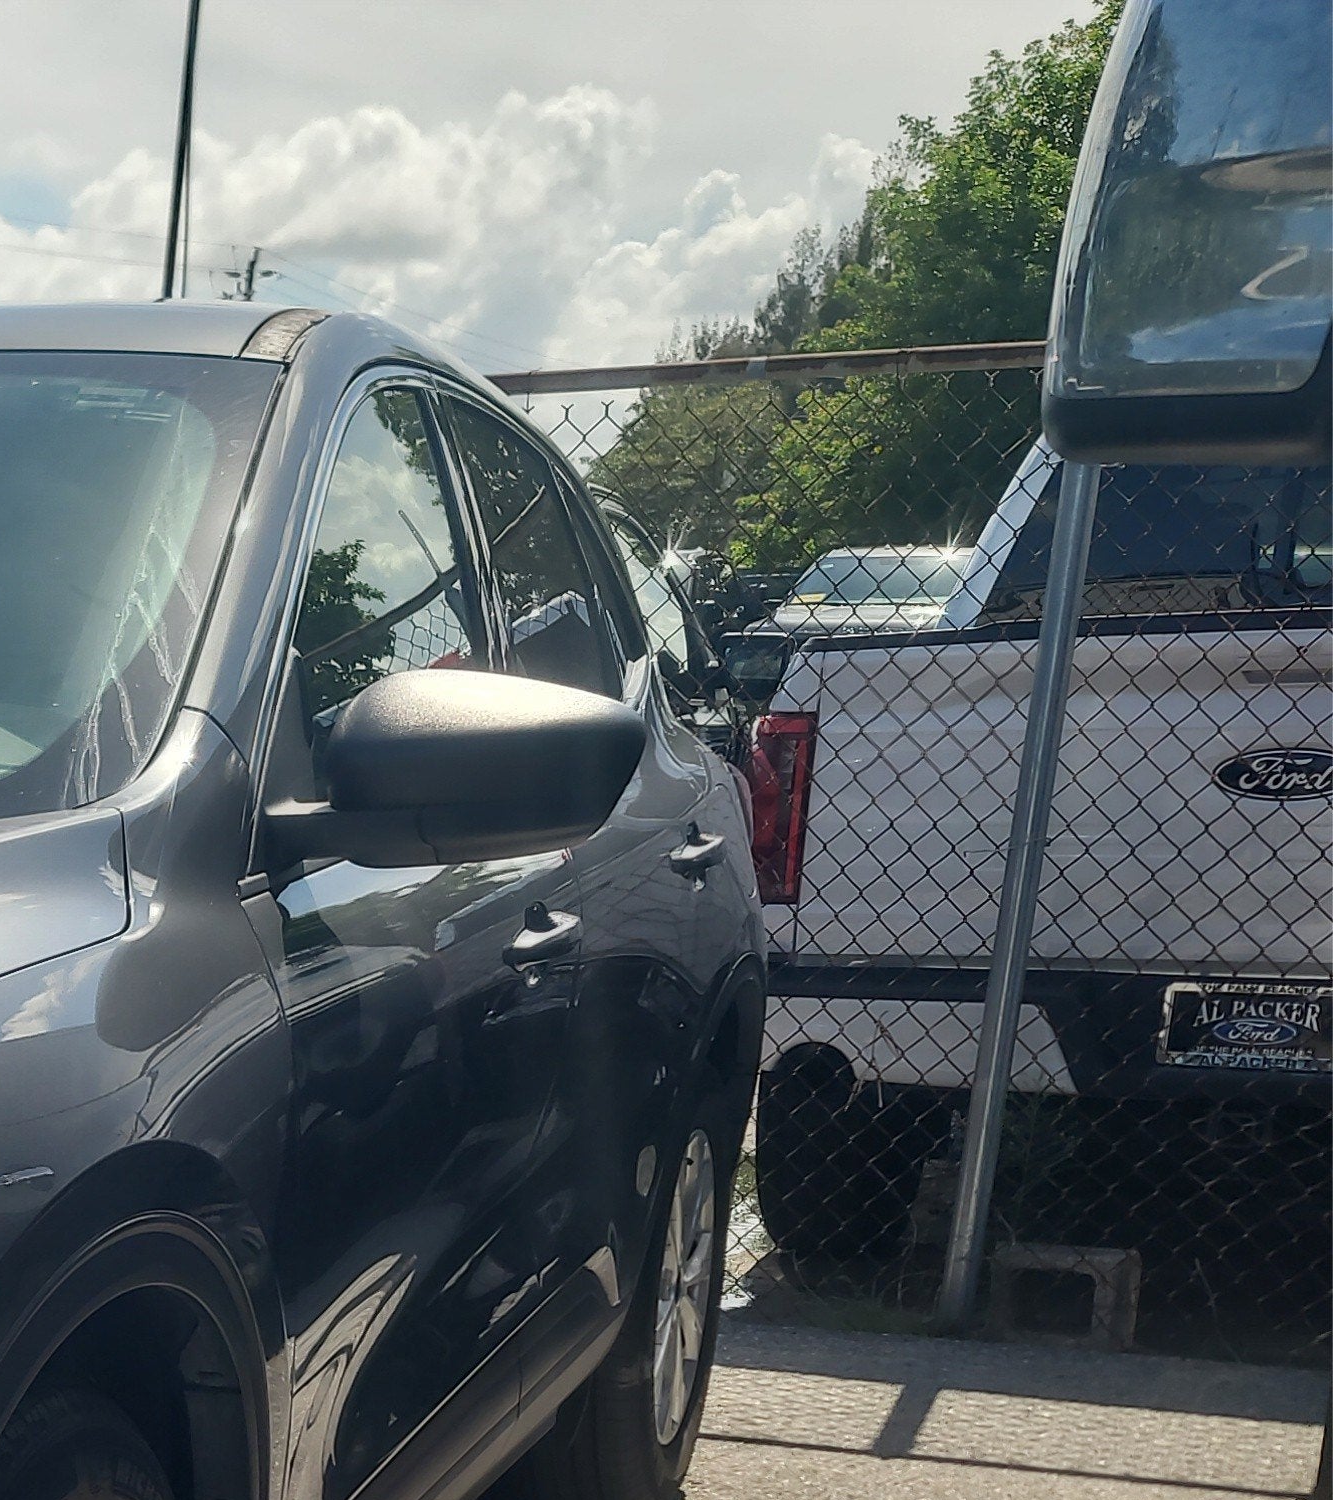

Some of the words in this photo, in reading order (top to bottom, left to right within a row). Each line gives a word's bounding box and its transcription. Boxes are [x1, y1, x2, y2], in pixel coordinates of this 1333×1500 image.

[1239, 756, 1333, 790] Ford
[1193, 1000, 1225, 1027] AL
[1233, 1000, 1321, 1032] PACKER
[1228, 1022, 1281, 1042] Ford
